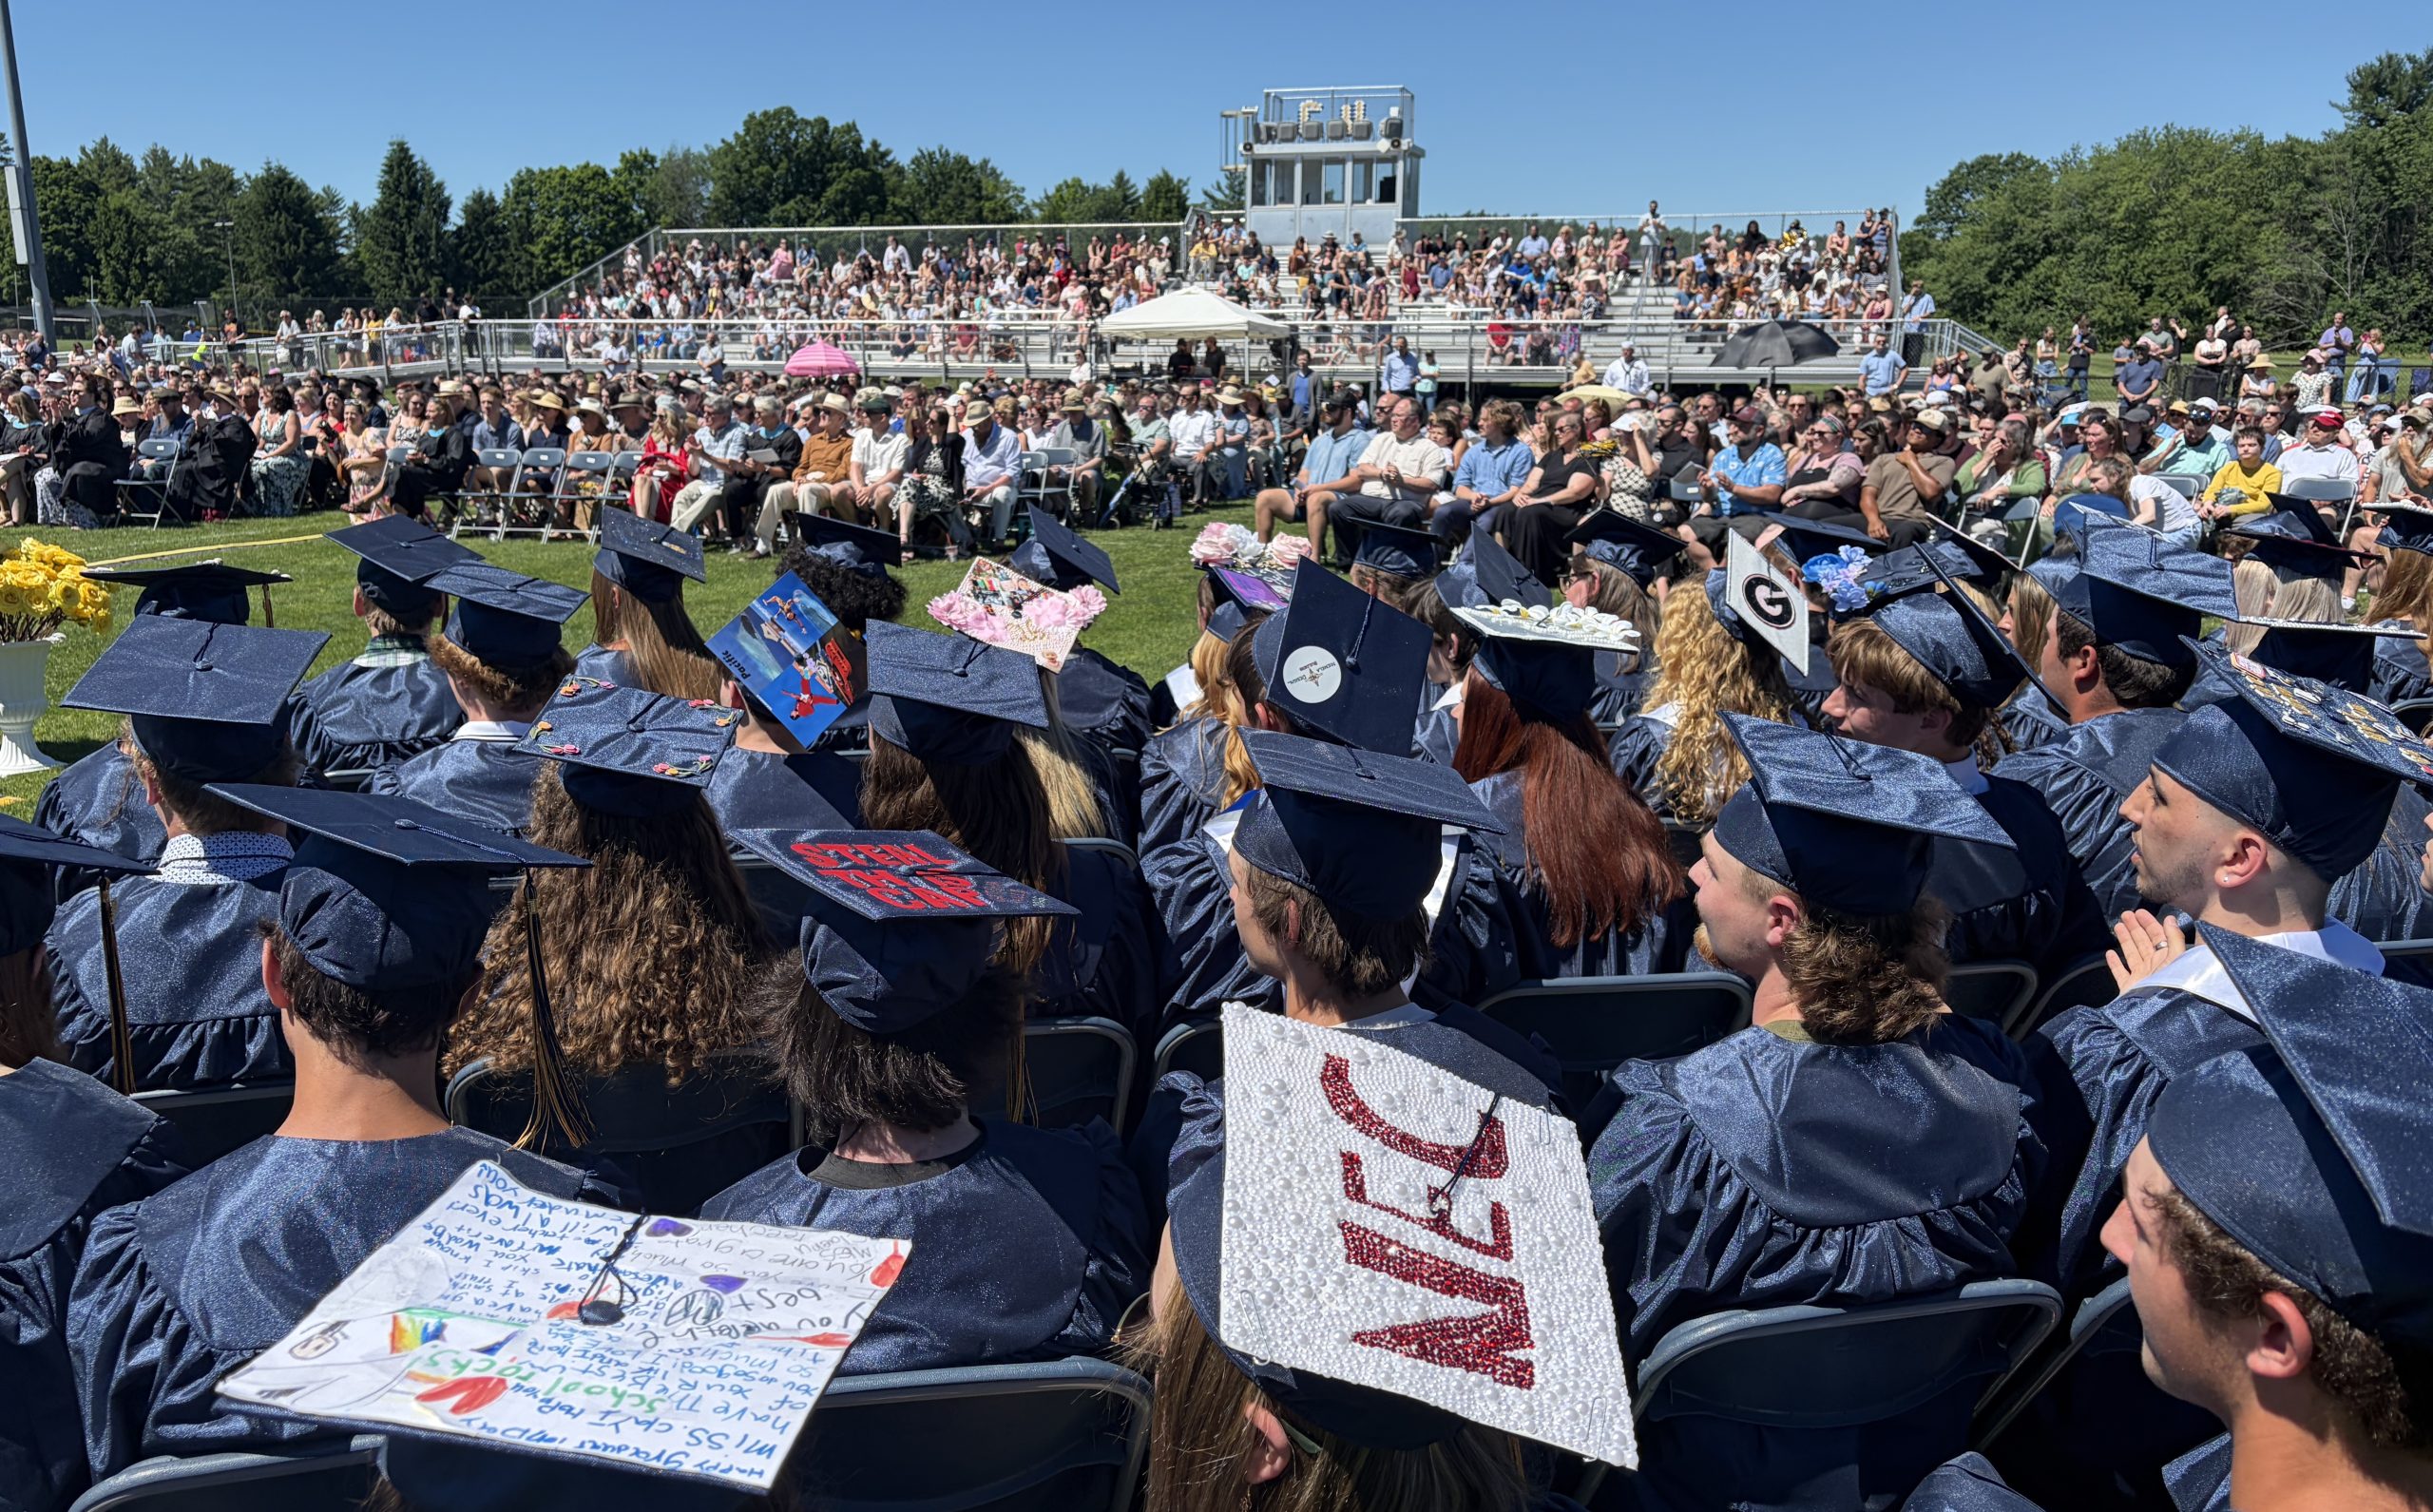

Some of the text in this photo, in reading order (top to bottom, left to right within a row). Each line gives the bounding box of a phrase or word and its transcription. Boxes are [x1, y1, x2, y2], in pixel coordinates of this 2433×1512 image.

[1754, 584, 1789, 617] G
[790, 843, 957, 868] STEAL
[866, 886, 987, 909] CAP
[1319, 1052, 1535, 1390] NEC
[731, 1288, 821, 1311] best
[768, 1394, 806, 1410] of
